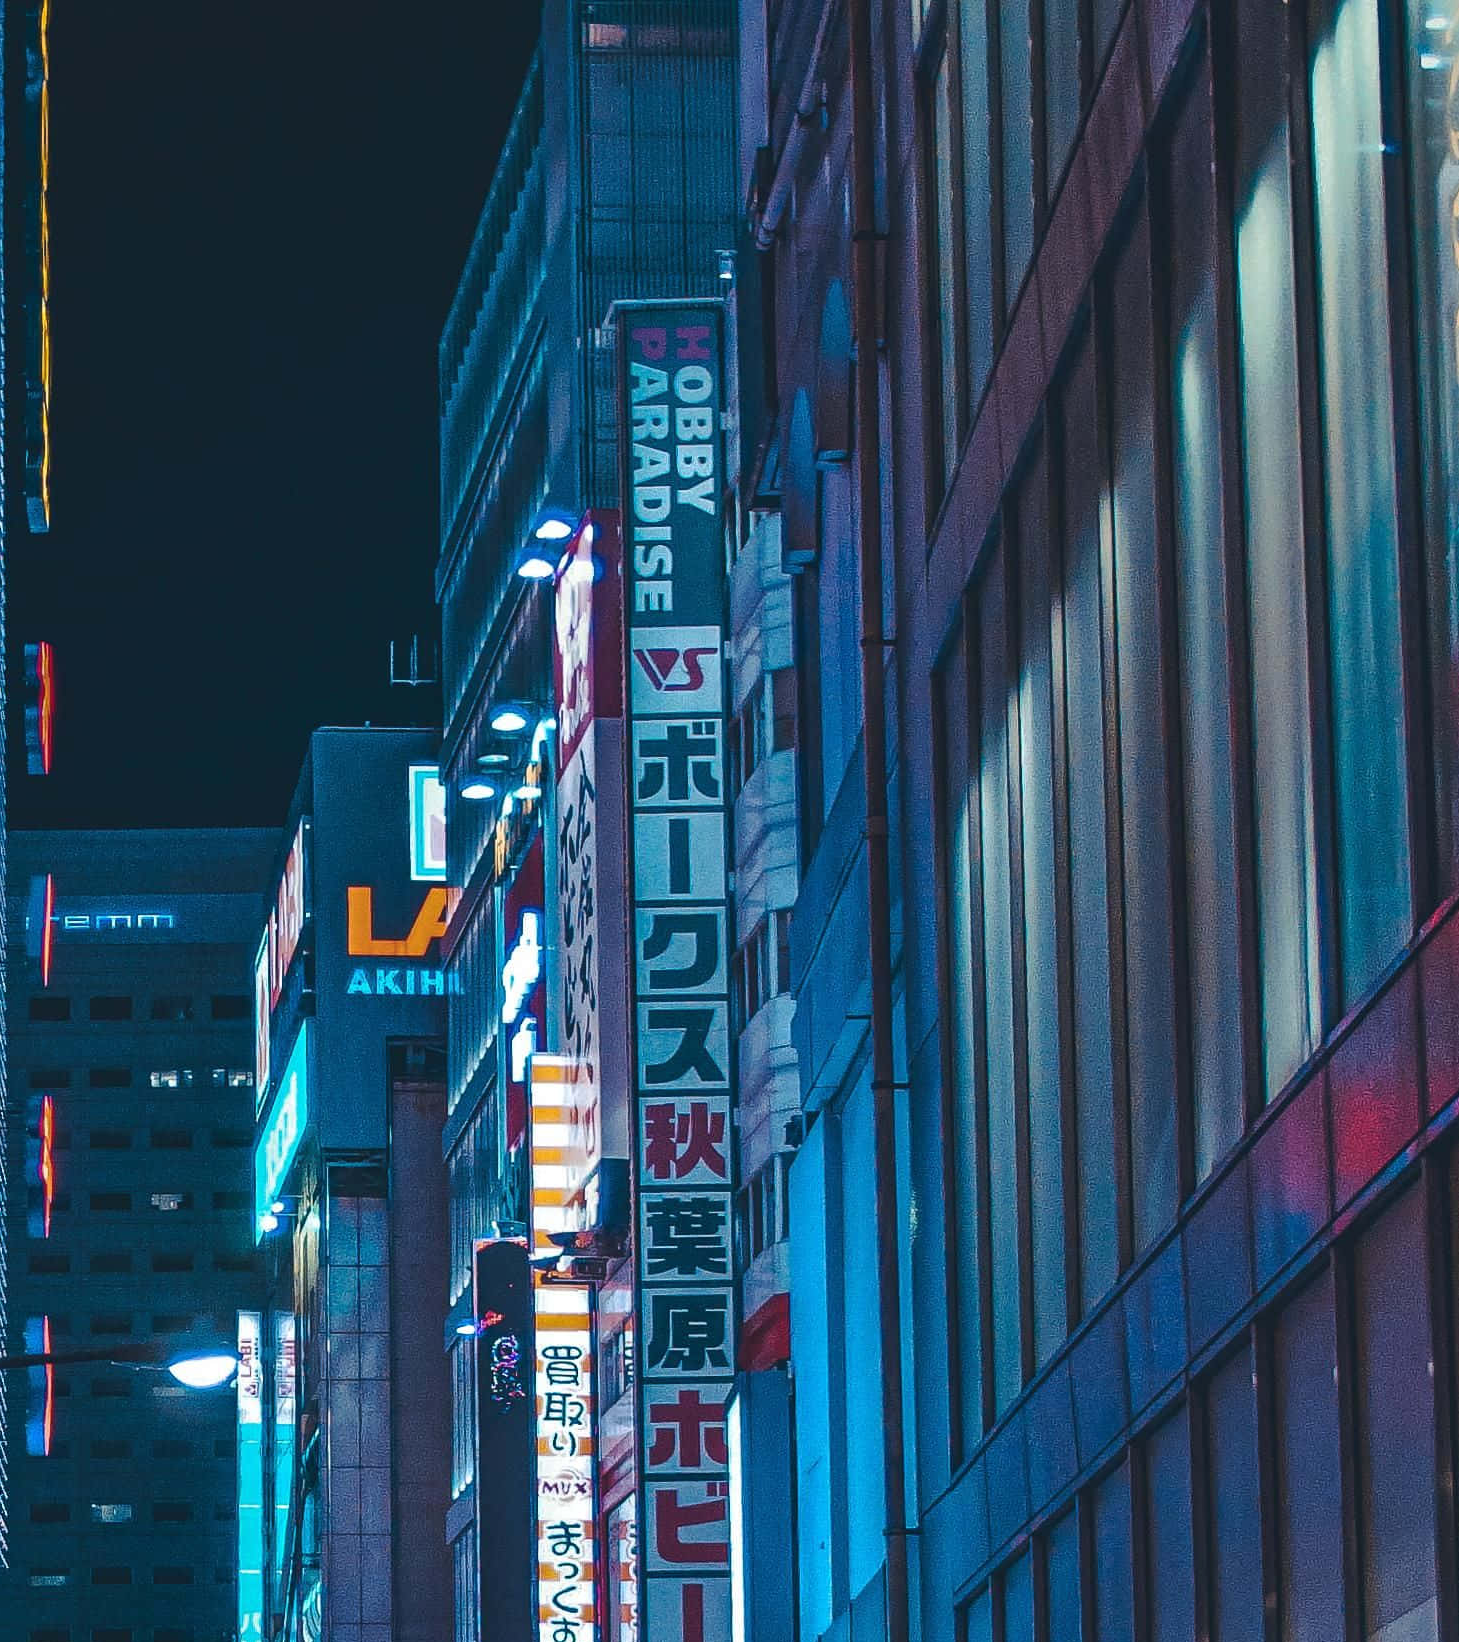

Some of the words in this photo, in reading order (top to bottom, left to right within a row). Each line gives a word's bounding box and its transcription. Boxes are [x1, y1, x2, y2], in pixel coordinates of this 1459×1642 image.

[630, 327, 674, 614] PARADISE
[673, 325, 716, 516] HOBBY
[240, 1338, 253, 1378] LABI
[542, 1345, 584, 1457] 買取り
